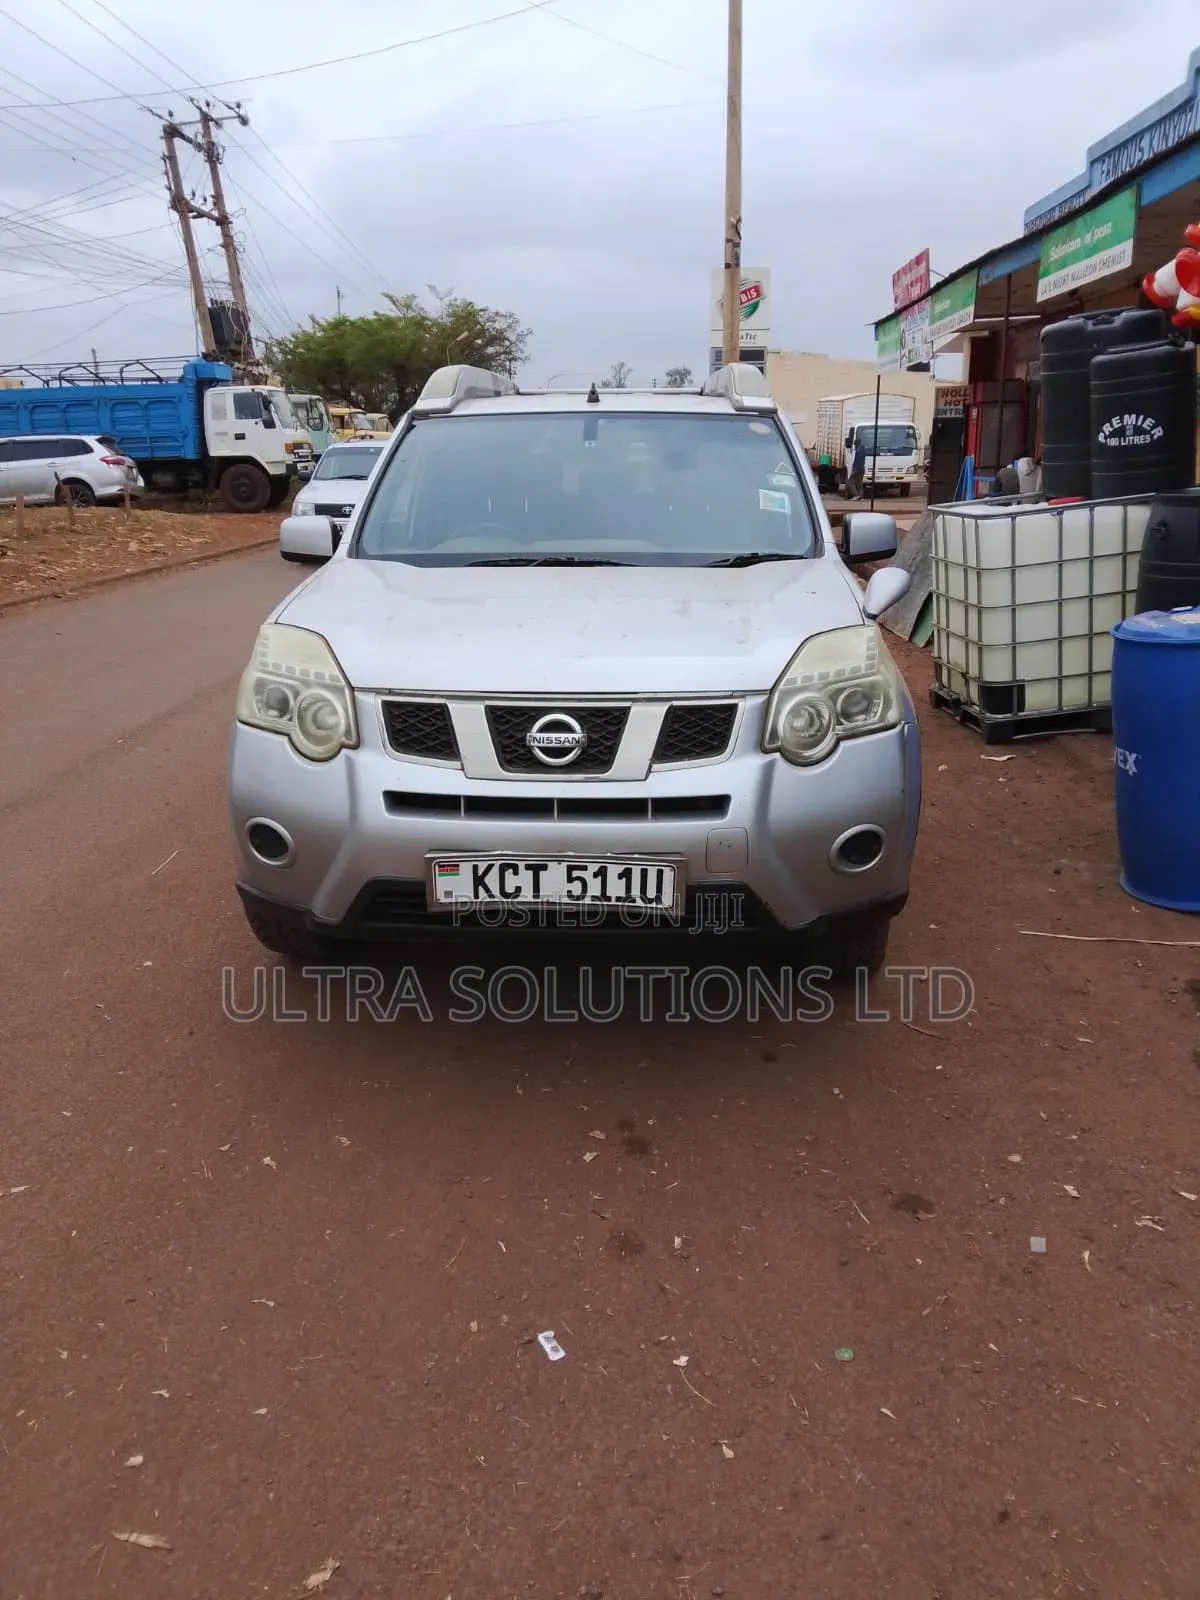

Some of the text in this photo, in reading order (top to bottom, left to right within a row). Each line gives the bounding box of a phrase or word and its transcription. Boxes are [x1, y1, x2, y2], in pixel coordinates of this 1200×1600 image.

[1100, 135, 1145, 183] FAMOUS
[1099, 249, 1126, 270] CHEMIST
[1098, 414, 1164, 443] PREMIER
[1107, 434, 1151, 446] 100 LITRES
[532, 736, 580, 746] NISSAN
[472, 862, 664, 904] KCT 511U
